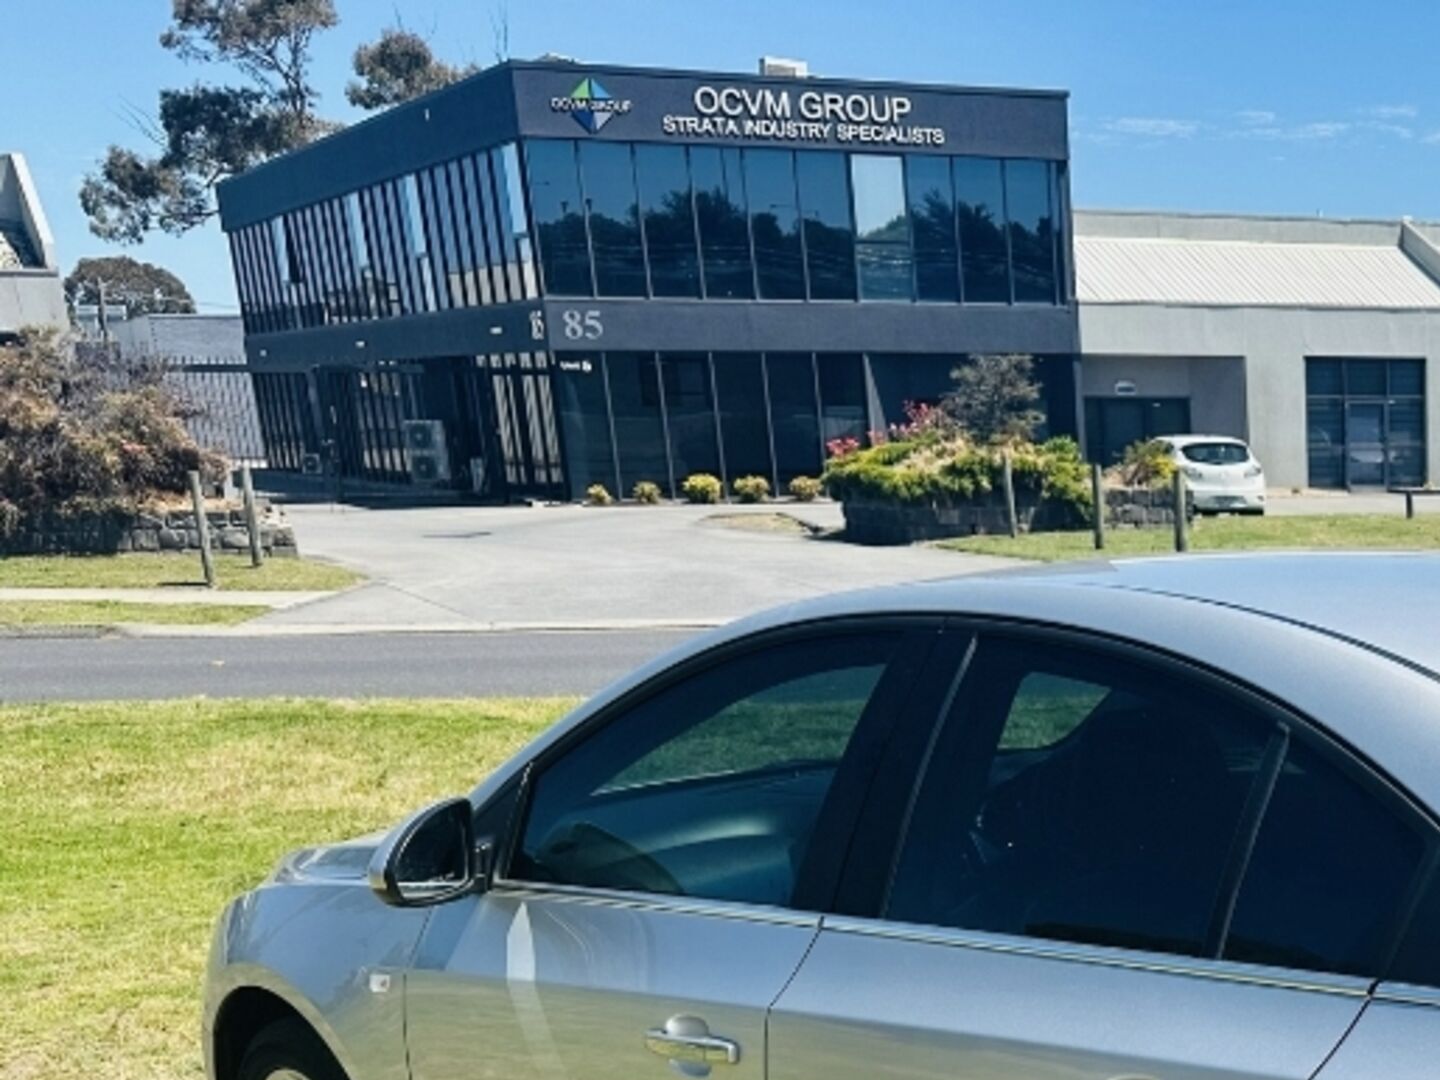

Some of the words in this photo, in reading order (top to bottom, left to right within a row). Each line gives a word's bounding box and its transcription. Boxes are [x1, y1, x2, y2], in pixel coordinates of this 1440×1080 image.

[694, 86, 790, 119] OCVM
[799, 91, 911, 123] GROUP
[662, 114, 738, 137] STRATA
[743, 119, 831, 140] INDUSTRY
[836, 123, 945, 145] SPECIALISTS
[562, 309, 604, 340] 85
